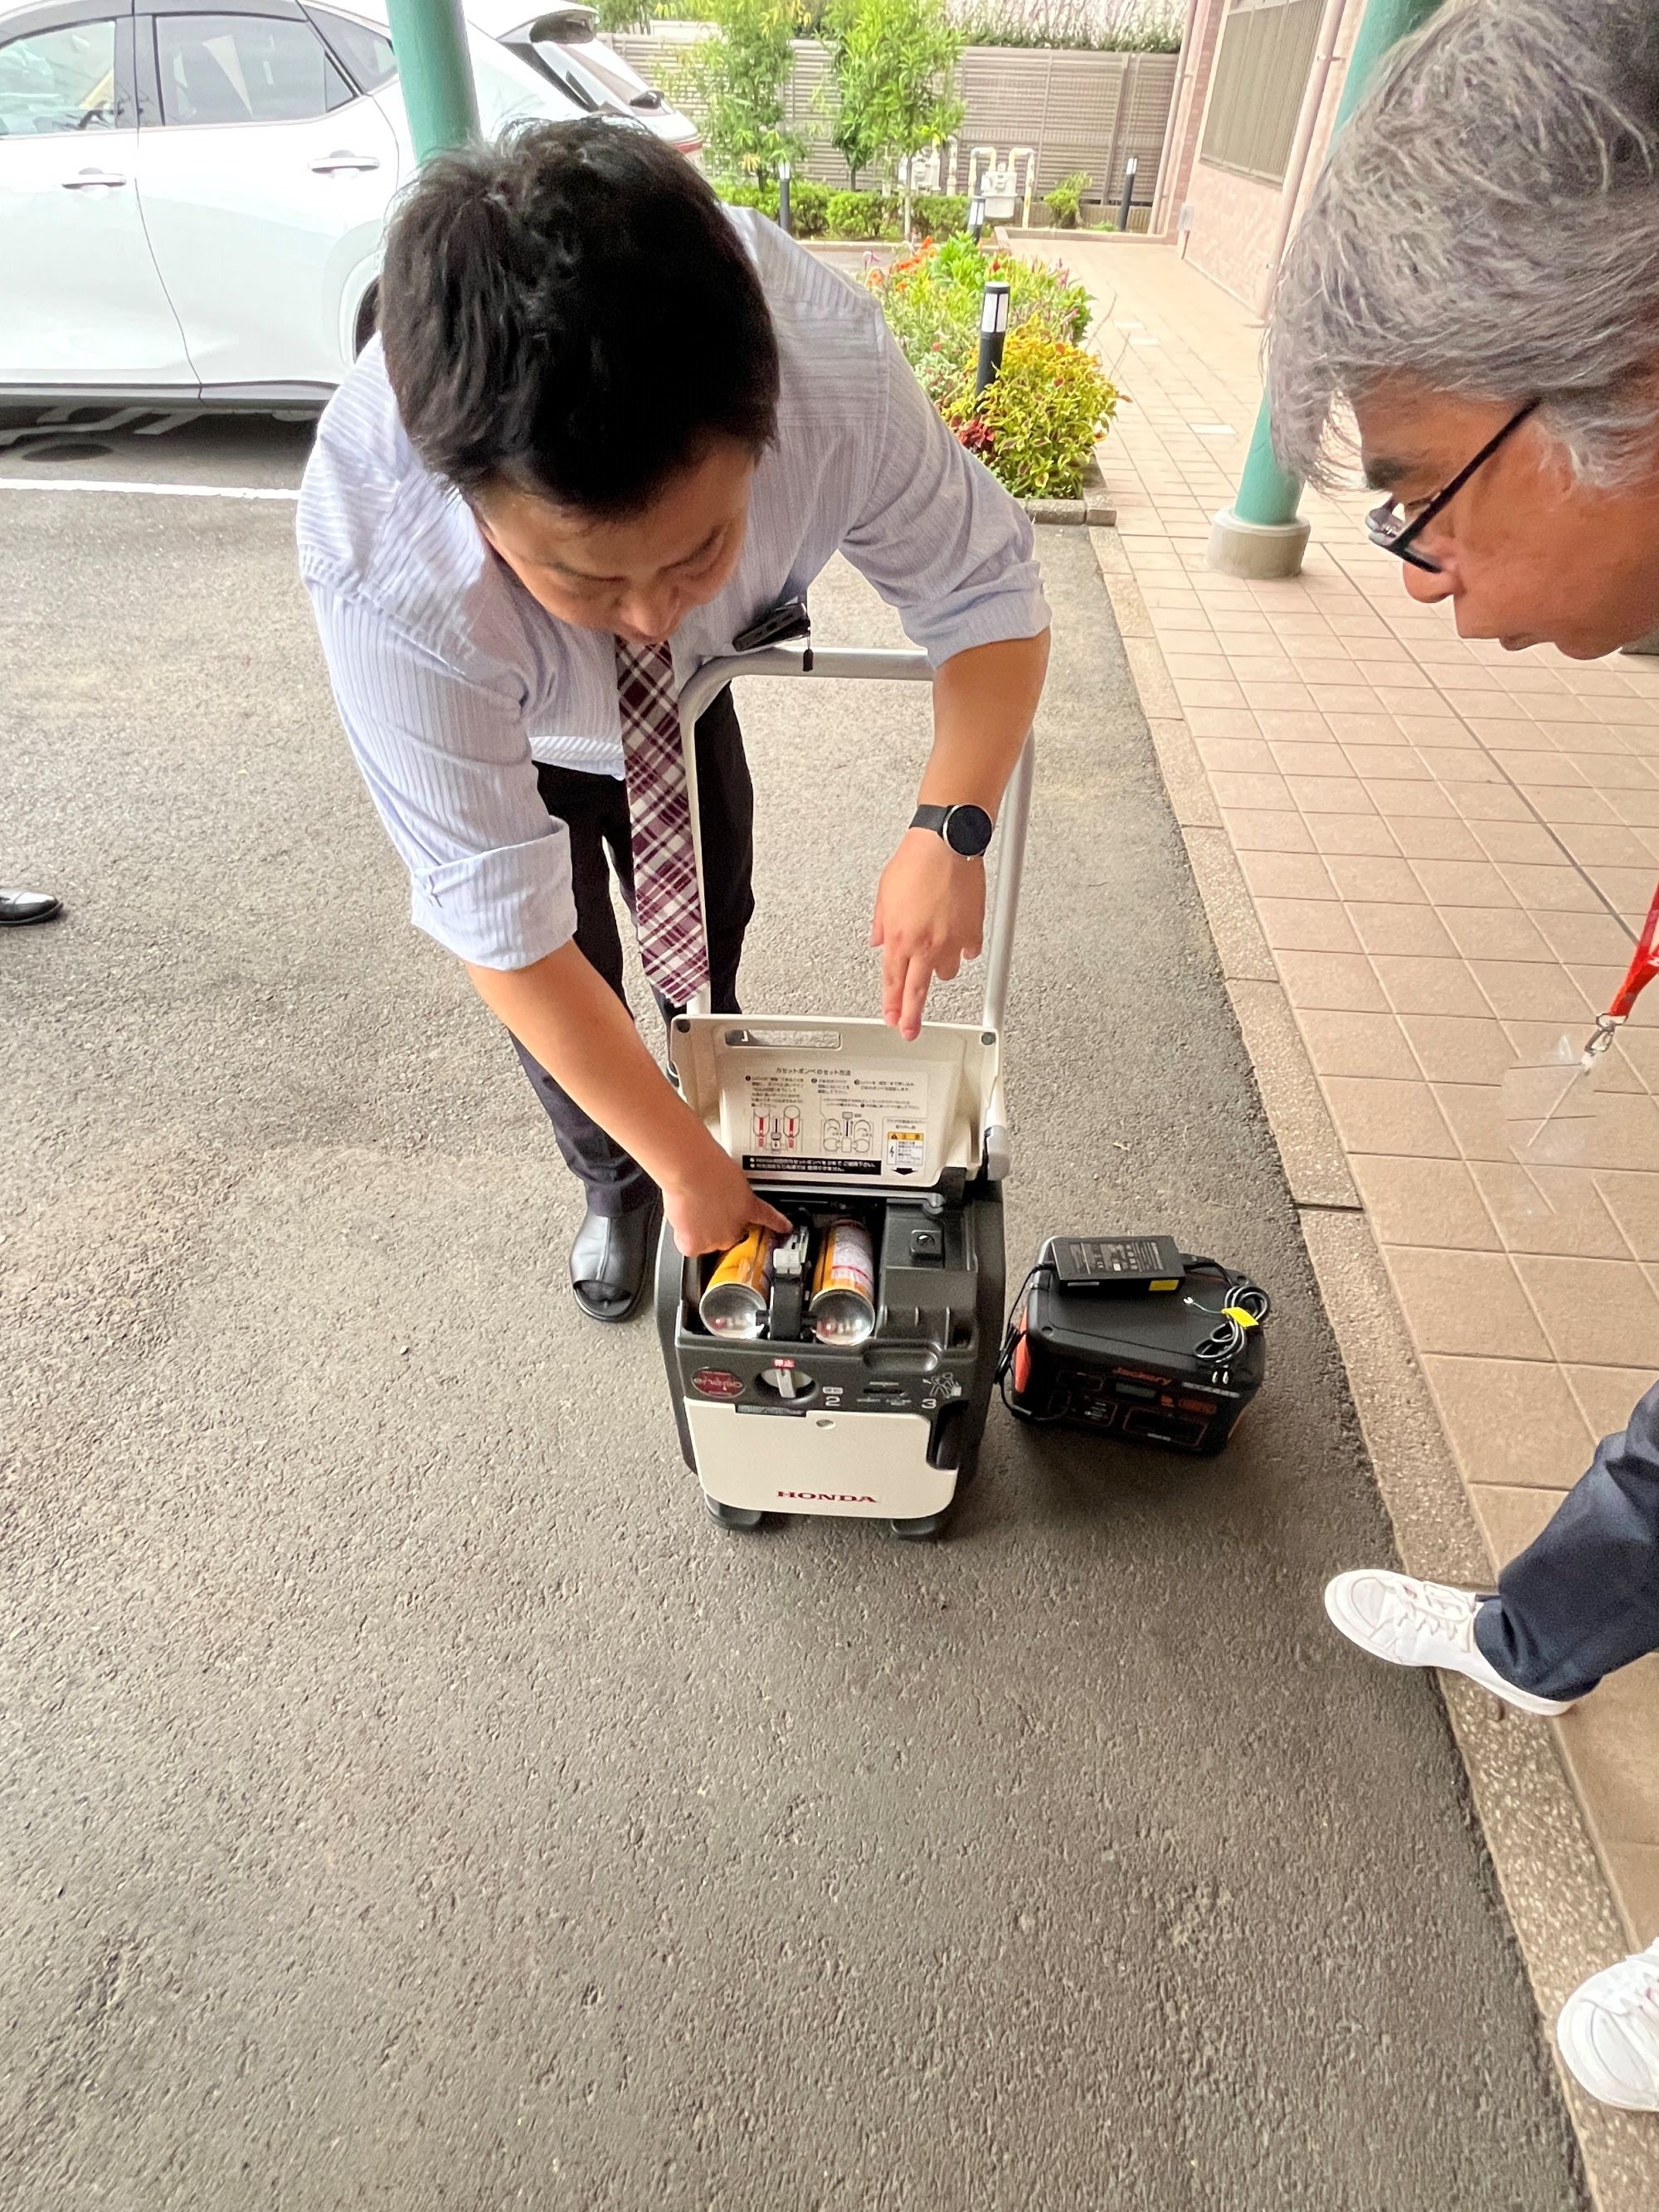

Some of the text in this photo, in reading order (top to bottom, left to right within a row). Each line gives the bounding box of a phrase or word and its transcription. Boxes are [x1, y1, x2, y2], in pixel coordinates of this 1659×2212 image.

[825, 1395, 841, 1407] 2
[921, 1398, 937, 1409] 3
[777, 1491, 877, 1503] HONDA
